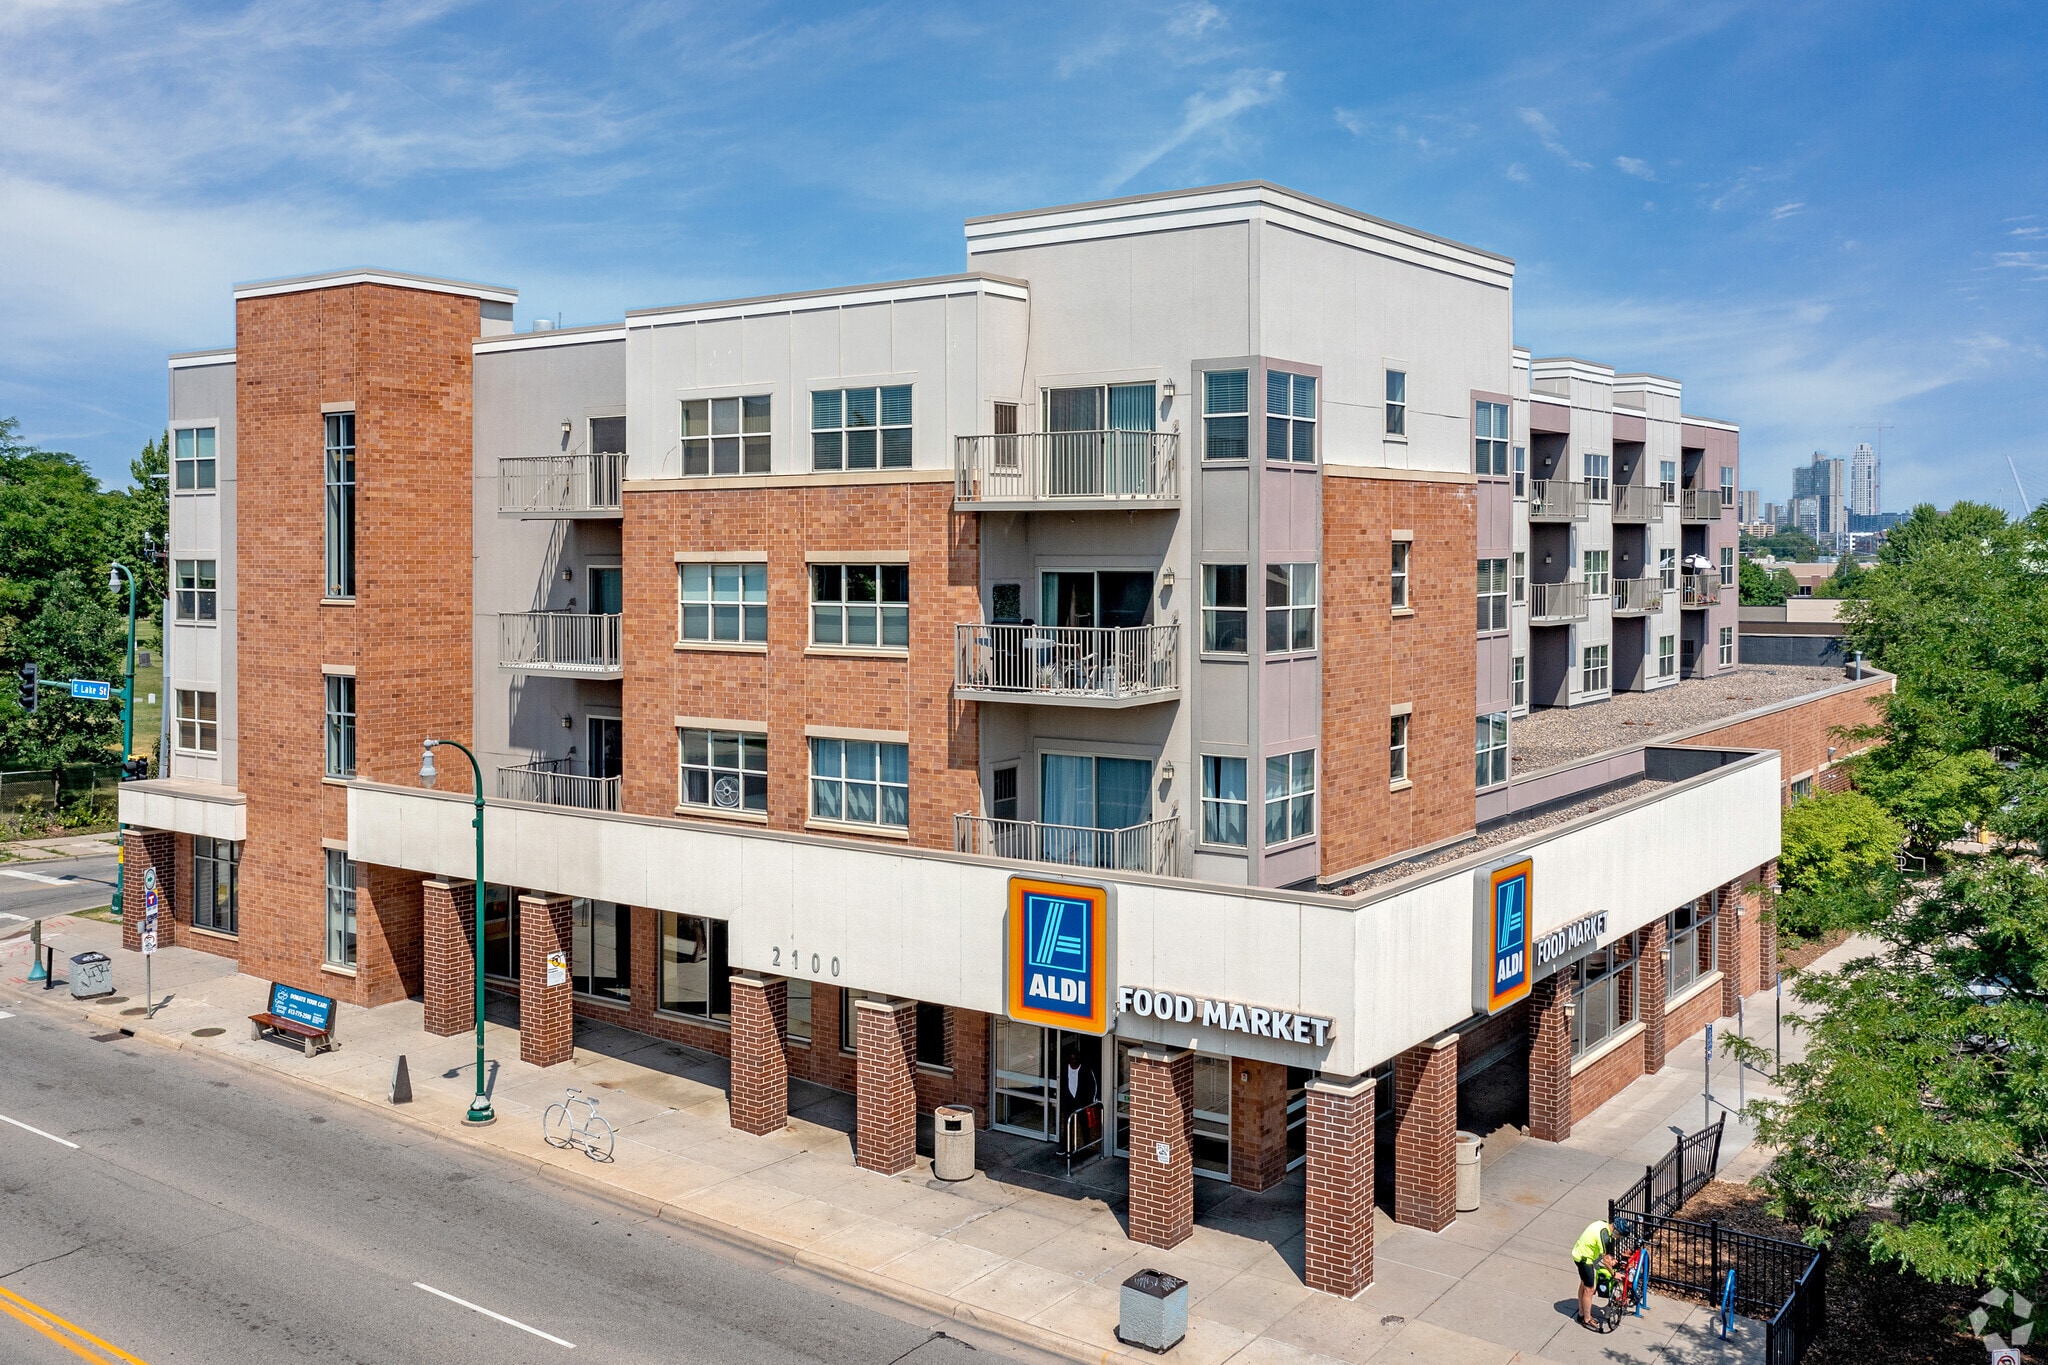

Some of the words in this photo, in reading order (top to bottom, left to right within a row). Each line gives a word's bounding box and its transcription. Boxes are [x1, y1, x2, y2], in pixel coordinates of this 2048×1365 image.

[74, 684, 78, 693] E
[80, 684, 97, 694] Lake
[99, 686, 107, 696] St
[1537, 931, 1566, 966] FOOD
[1568, 911, 1608, 951] MARKET
[772, 946, 841, 977] 2100
[1496, 950, 1524, 984] ALDI
[290, 993, 306, 1003] DONATE
[306, 998, 318, 1006] YOUR
[1028, 973, 1086, 1005] ALDI
[1119, 986, 1195, 1023] FOOD
[1202, 999, 1331, 1047] MARKET
